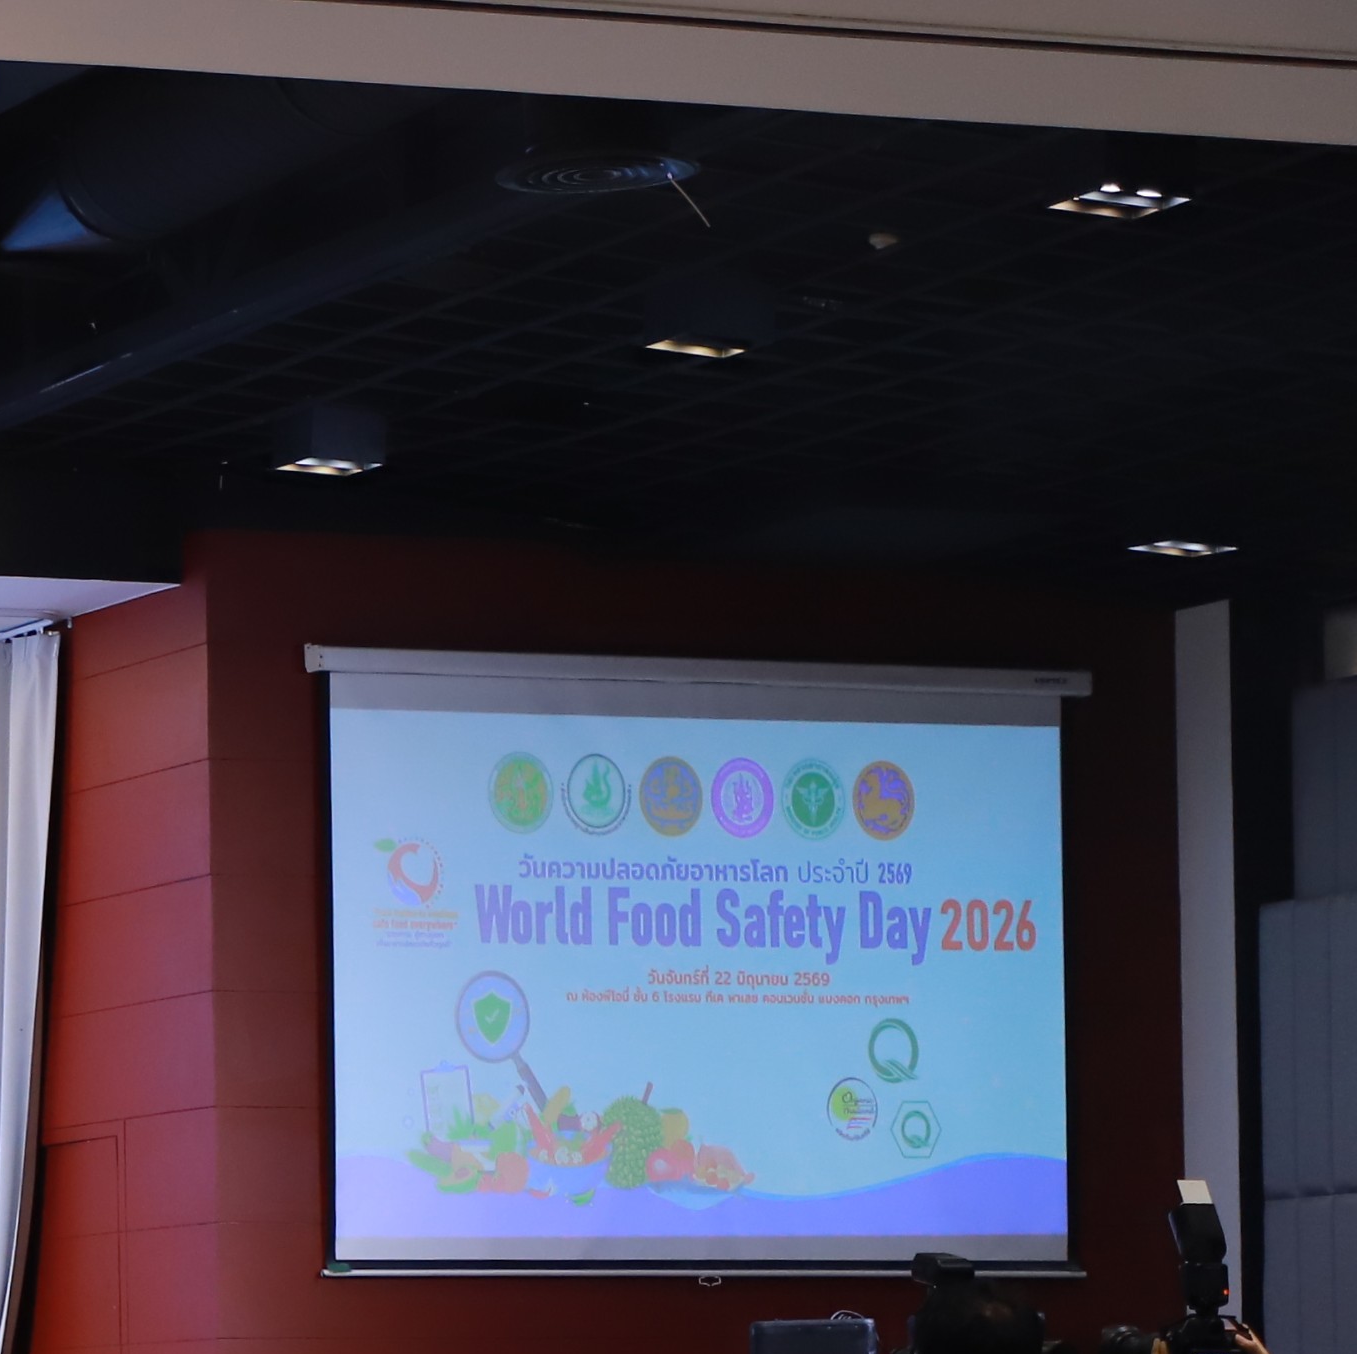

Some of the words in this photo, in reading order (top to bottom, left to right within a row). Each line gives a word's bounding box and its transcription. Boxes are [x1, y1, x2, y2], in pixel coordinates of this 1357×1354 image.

[519, 853, 789, 883] วันความปลอดภัยอาหารโลก
[798, 858, 870, 884] ประจำปี
[878, 863, 913, 884] 2569
[474, 884, 594, 946] World
[608, 886, 701, 948] Food
[716, 888, 846, 965] Safety
[859, 890, 932, 966] Day
[940, 898, 1037, 952] 2026
[715, 971, 732, 986] 22
[794, 972, 830, 987] 2569
[652, 992, 660, 1003] 6
